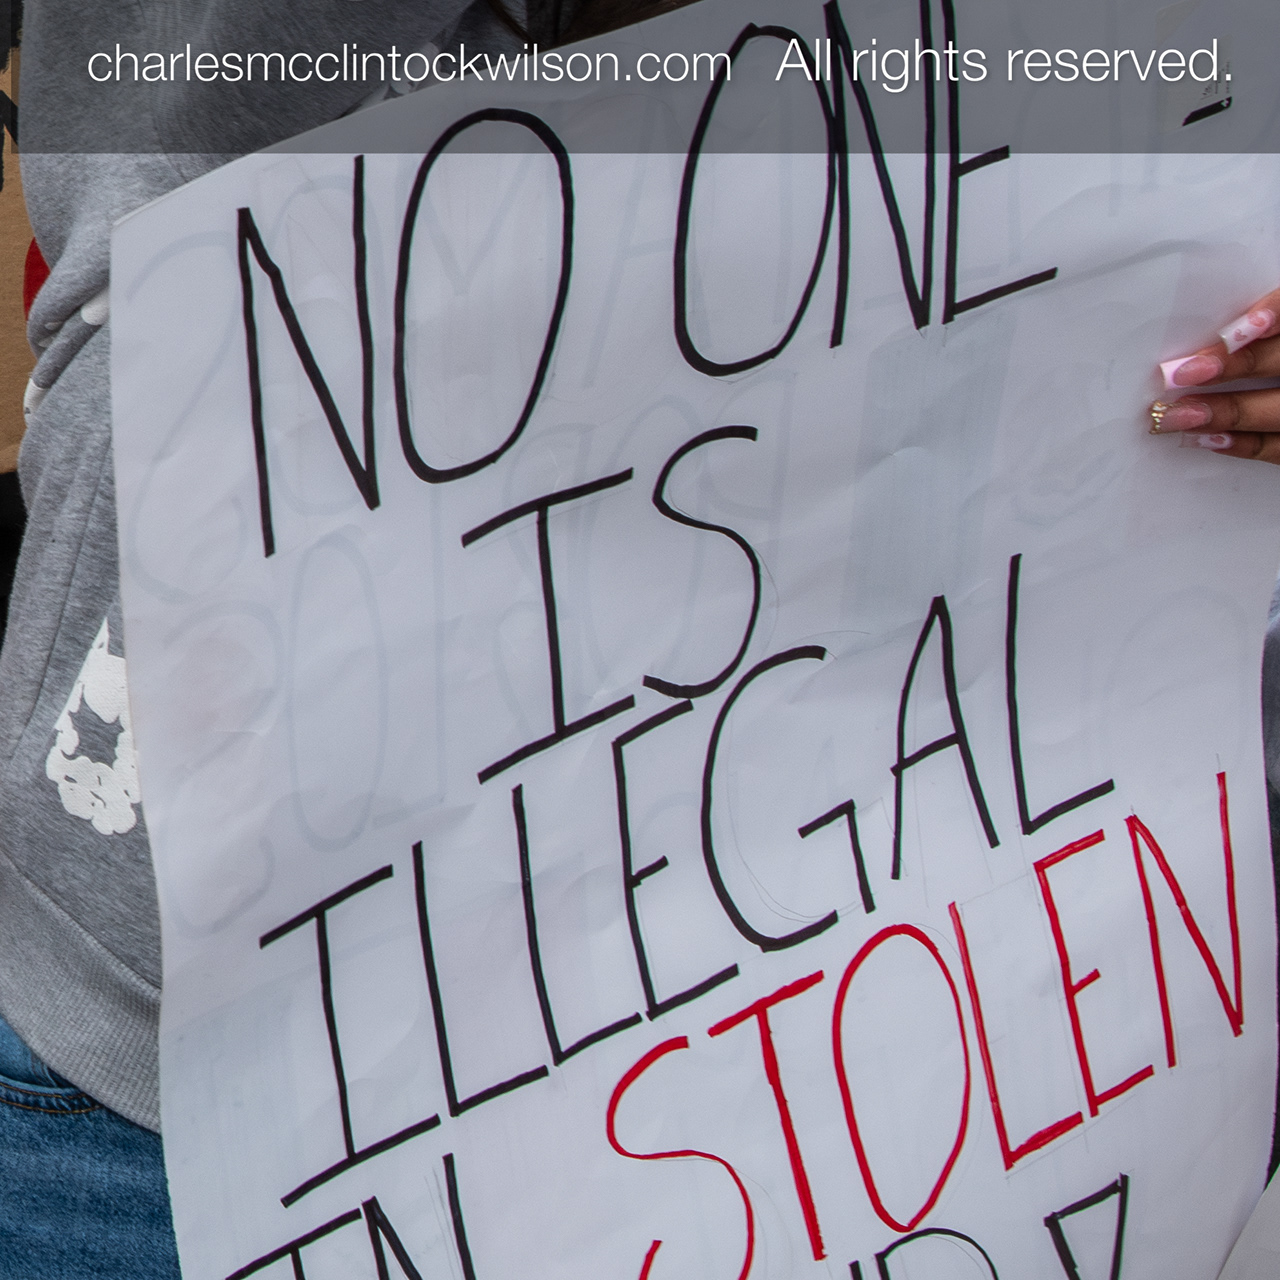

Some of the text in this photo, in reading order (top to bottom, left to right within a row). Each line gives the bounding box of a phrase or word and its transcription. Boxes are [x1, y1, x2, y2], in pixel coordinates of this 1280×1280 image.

[237, 107, 576, 558] NO
[460, 425, 764, 785] IS
[258, 553, 1115, 1207] ILLEGAL
[605, 770, 1245, 1280] STOLEN
